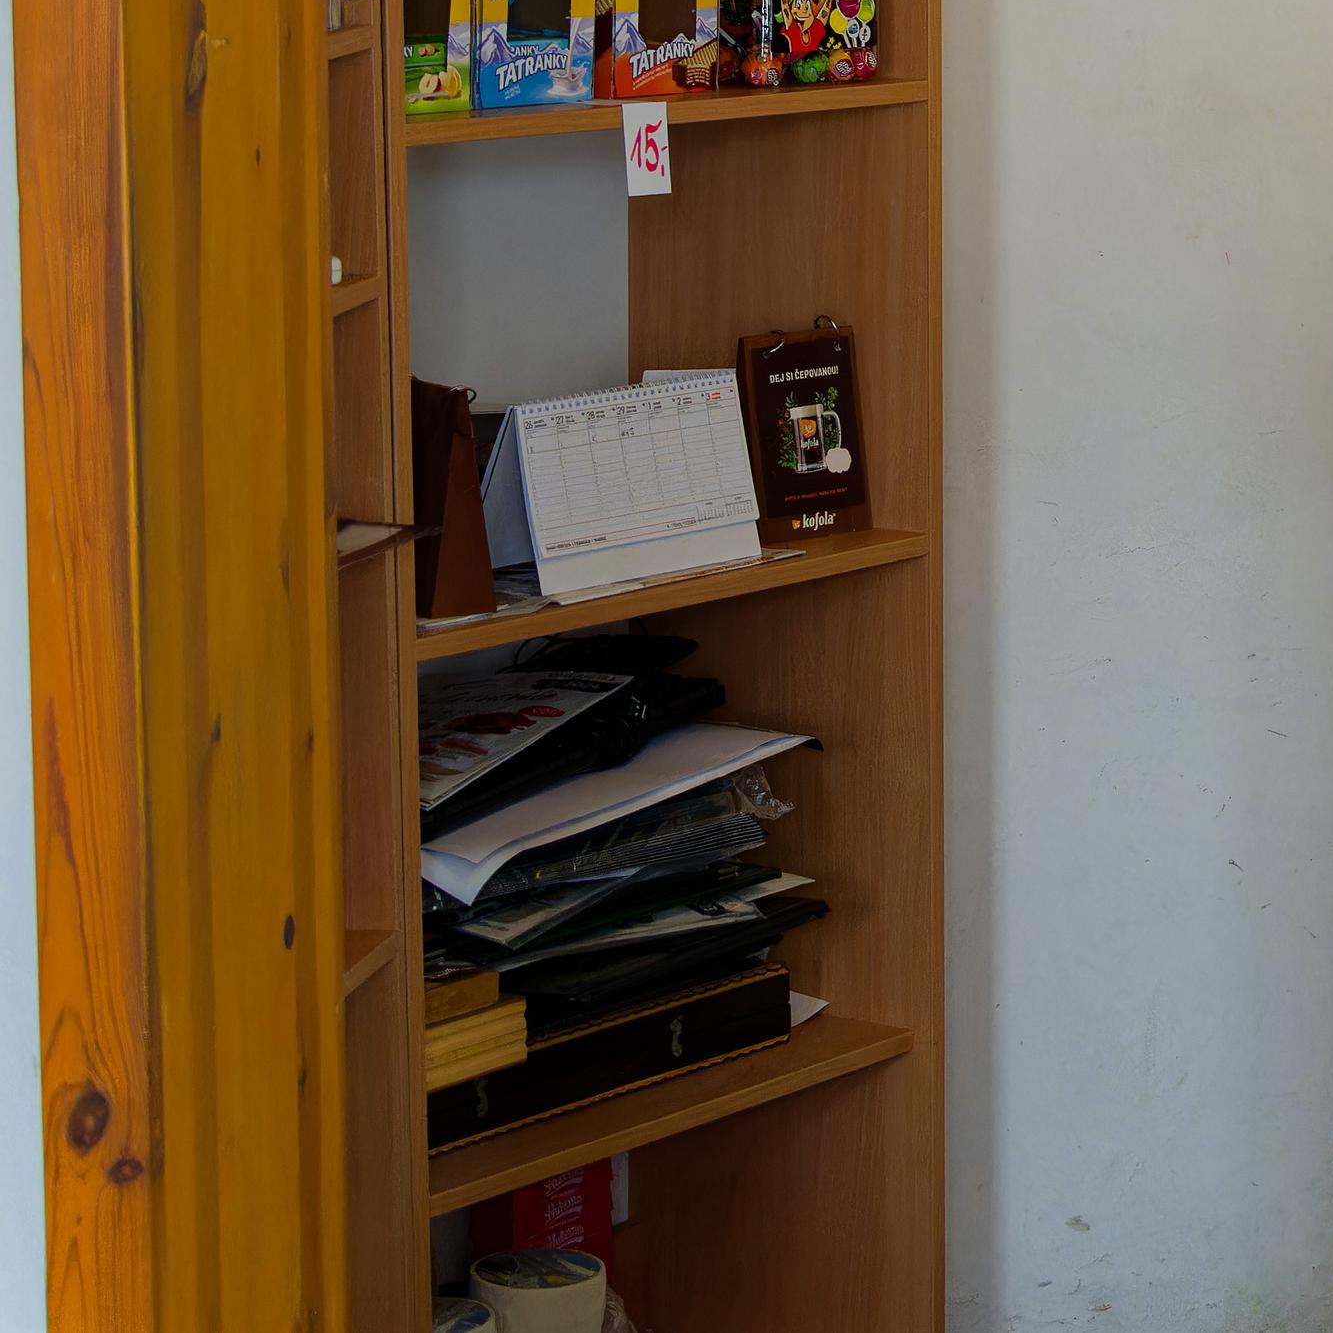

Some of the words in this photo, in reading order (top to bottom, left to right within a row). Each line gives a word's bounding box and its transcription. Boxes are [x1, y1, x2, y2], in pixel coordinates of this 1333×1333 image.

[496, 53, 569, 91] TATRANKY
[629, 42, 695, 79] TATRANKY
[769, 373, 785, 384] DEJ
[785, 371, 794, 381] SI
[794, 365, 840, 380] ČEPOVANOU!
[802, 511, 836, 531] kofola
